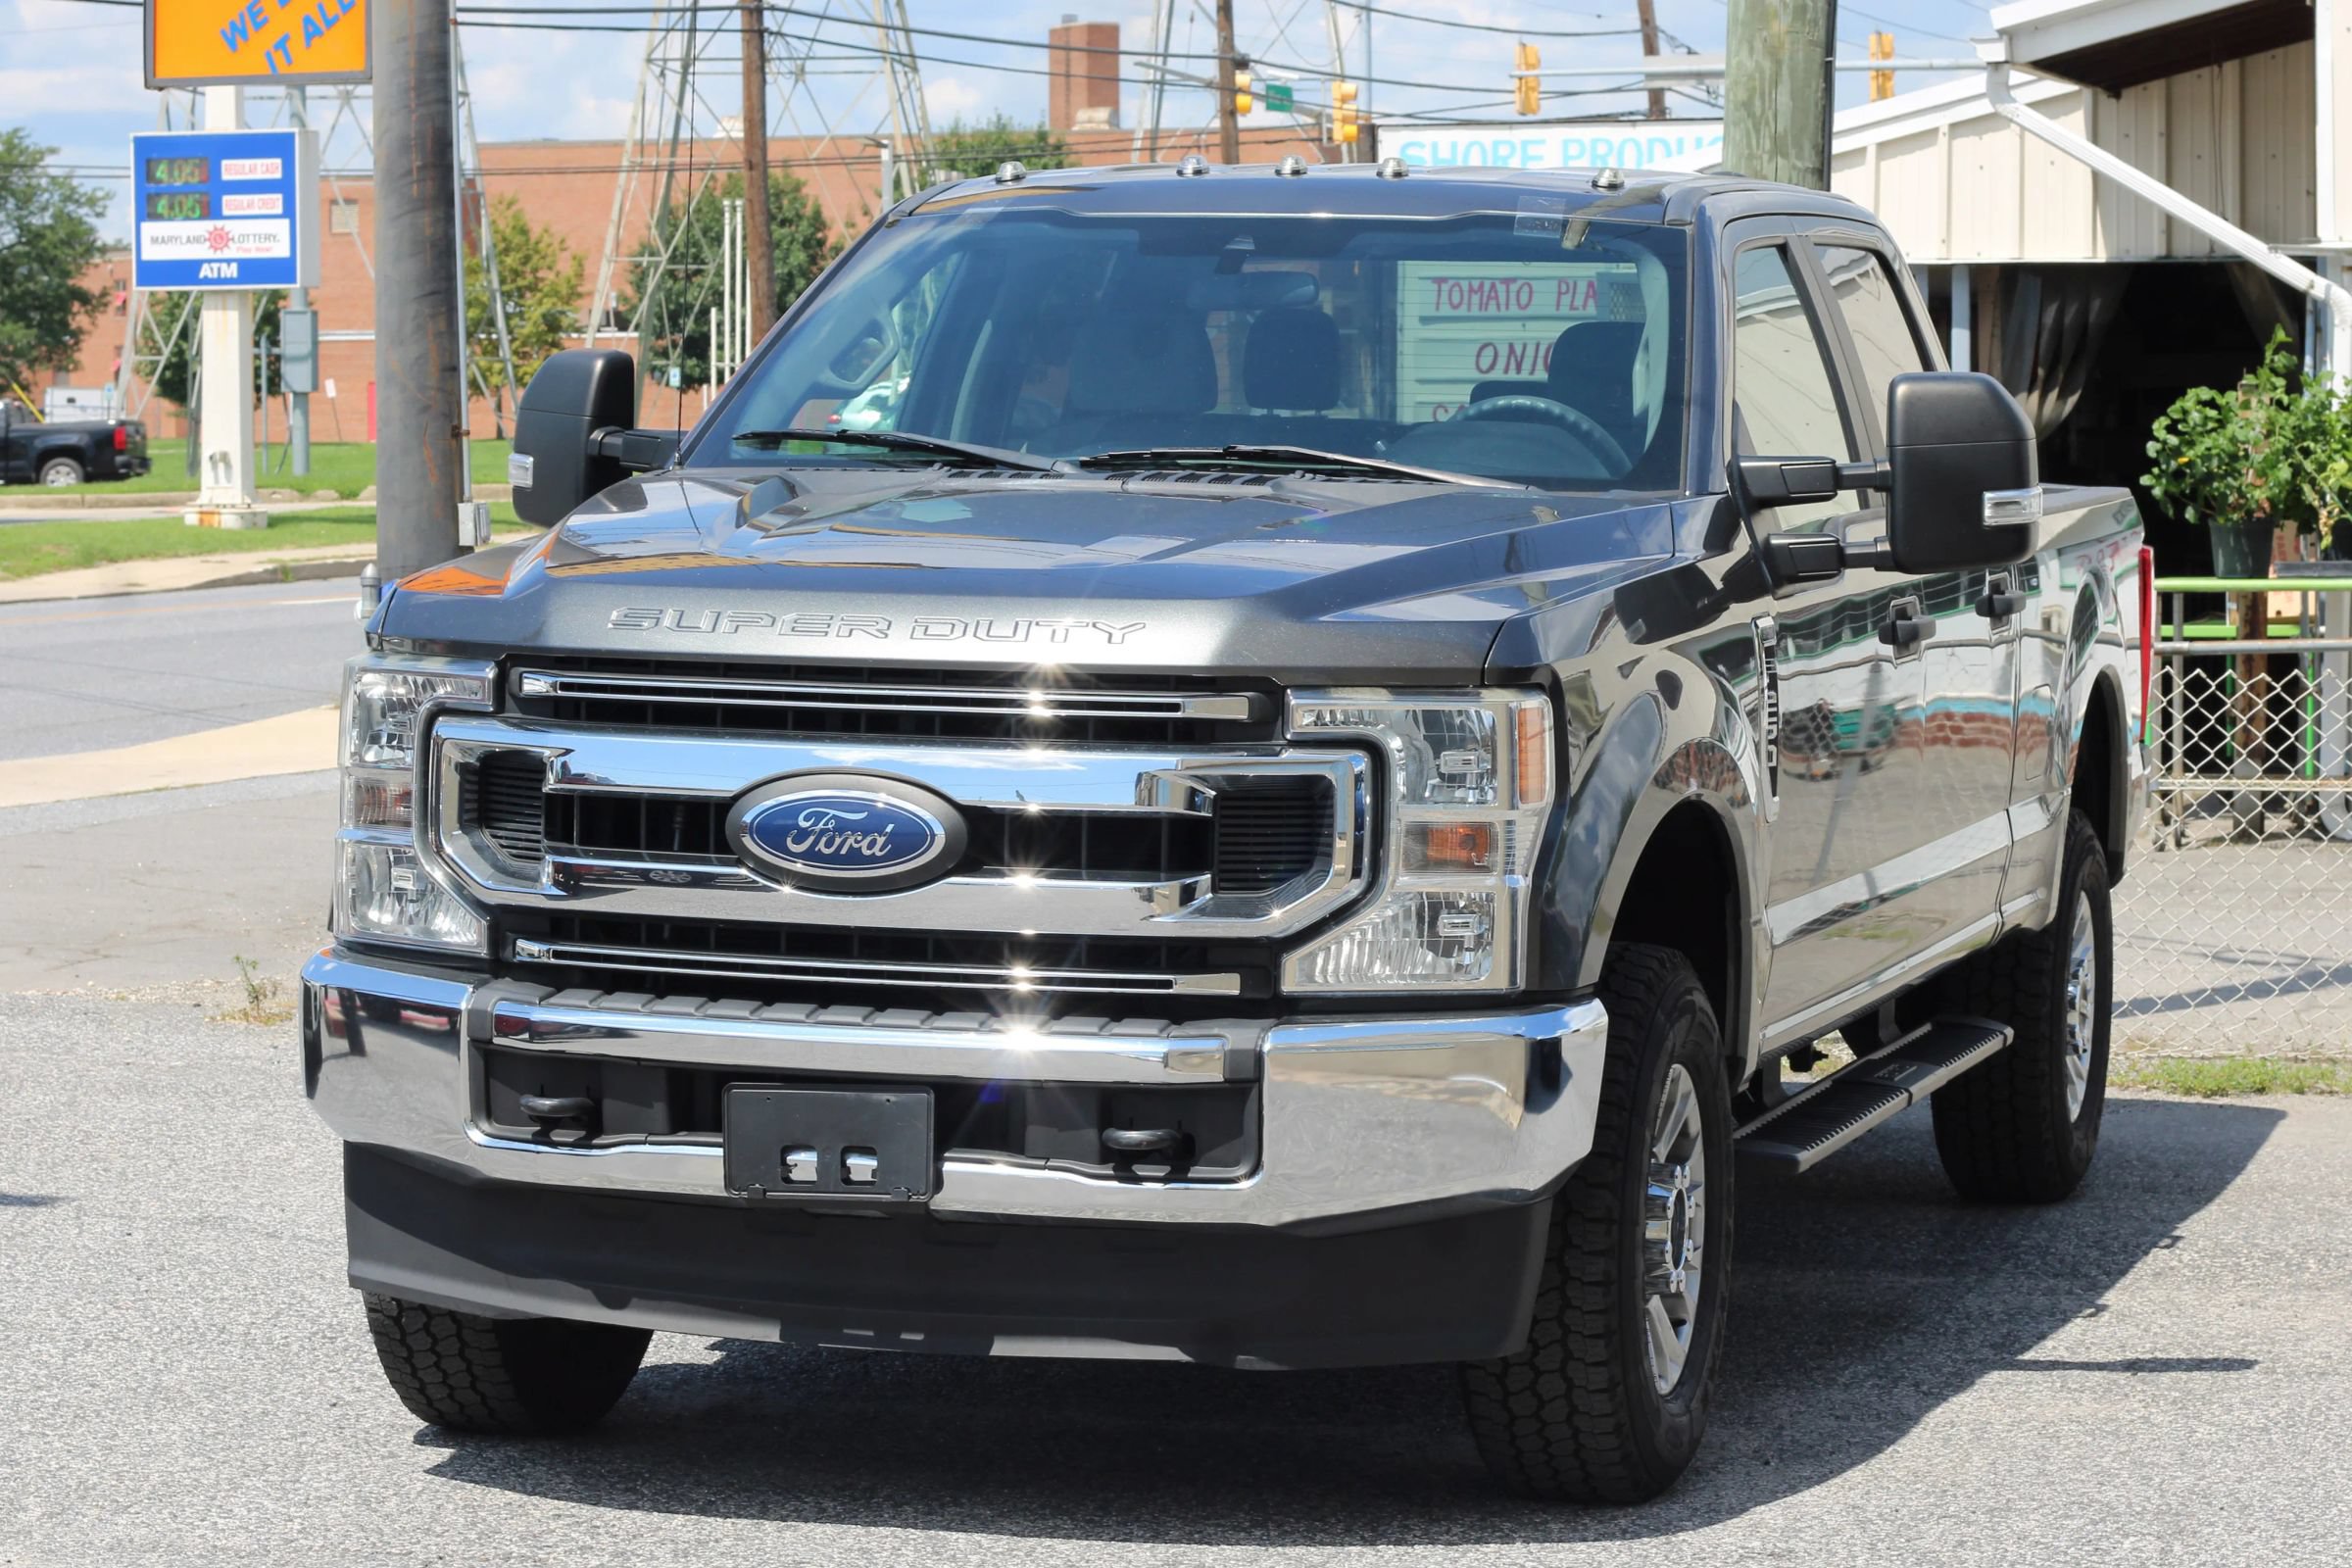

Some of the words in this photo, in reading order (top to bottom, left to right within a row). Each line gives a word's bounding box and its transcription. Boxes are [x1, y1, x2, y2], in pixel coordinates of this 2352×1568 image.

[220, 0, 270, 53] WE
[265, 31, 293, 75] IT
[1398, 138, 1546, 168] SHORE
[1561, 135, 1724, 169] PROD
[150, 234, 206, 246] MARYLAND
[232, 232, 277, 244] LOTTERY
[199, 262, 238, 279] ATM
[1432, 276, 1534, 313] TOMATO
[607, 606, 893, 640] SUPER
[909, 615, 1148, 645] DUTY
[786, 808, 897, 857] Ford
